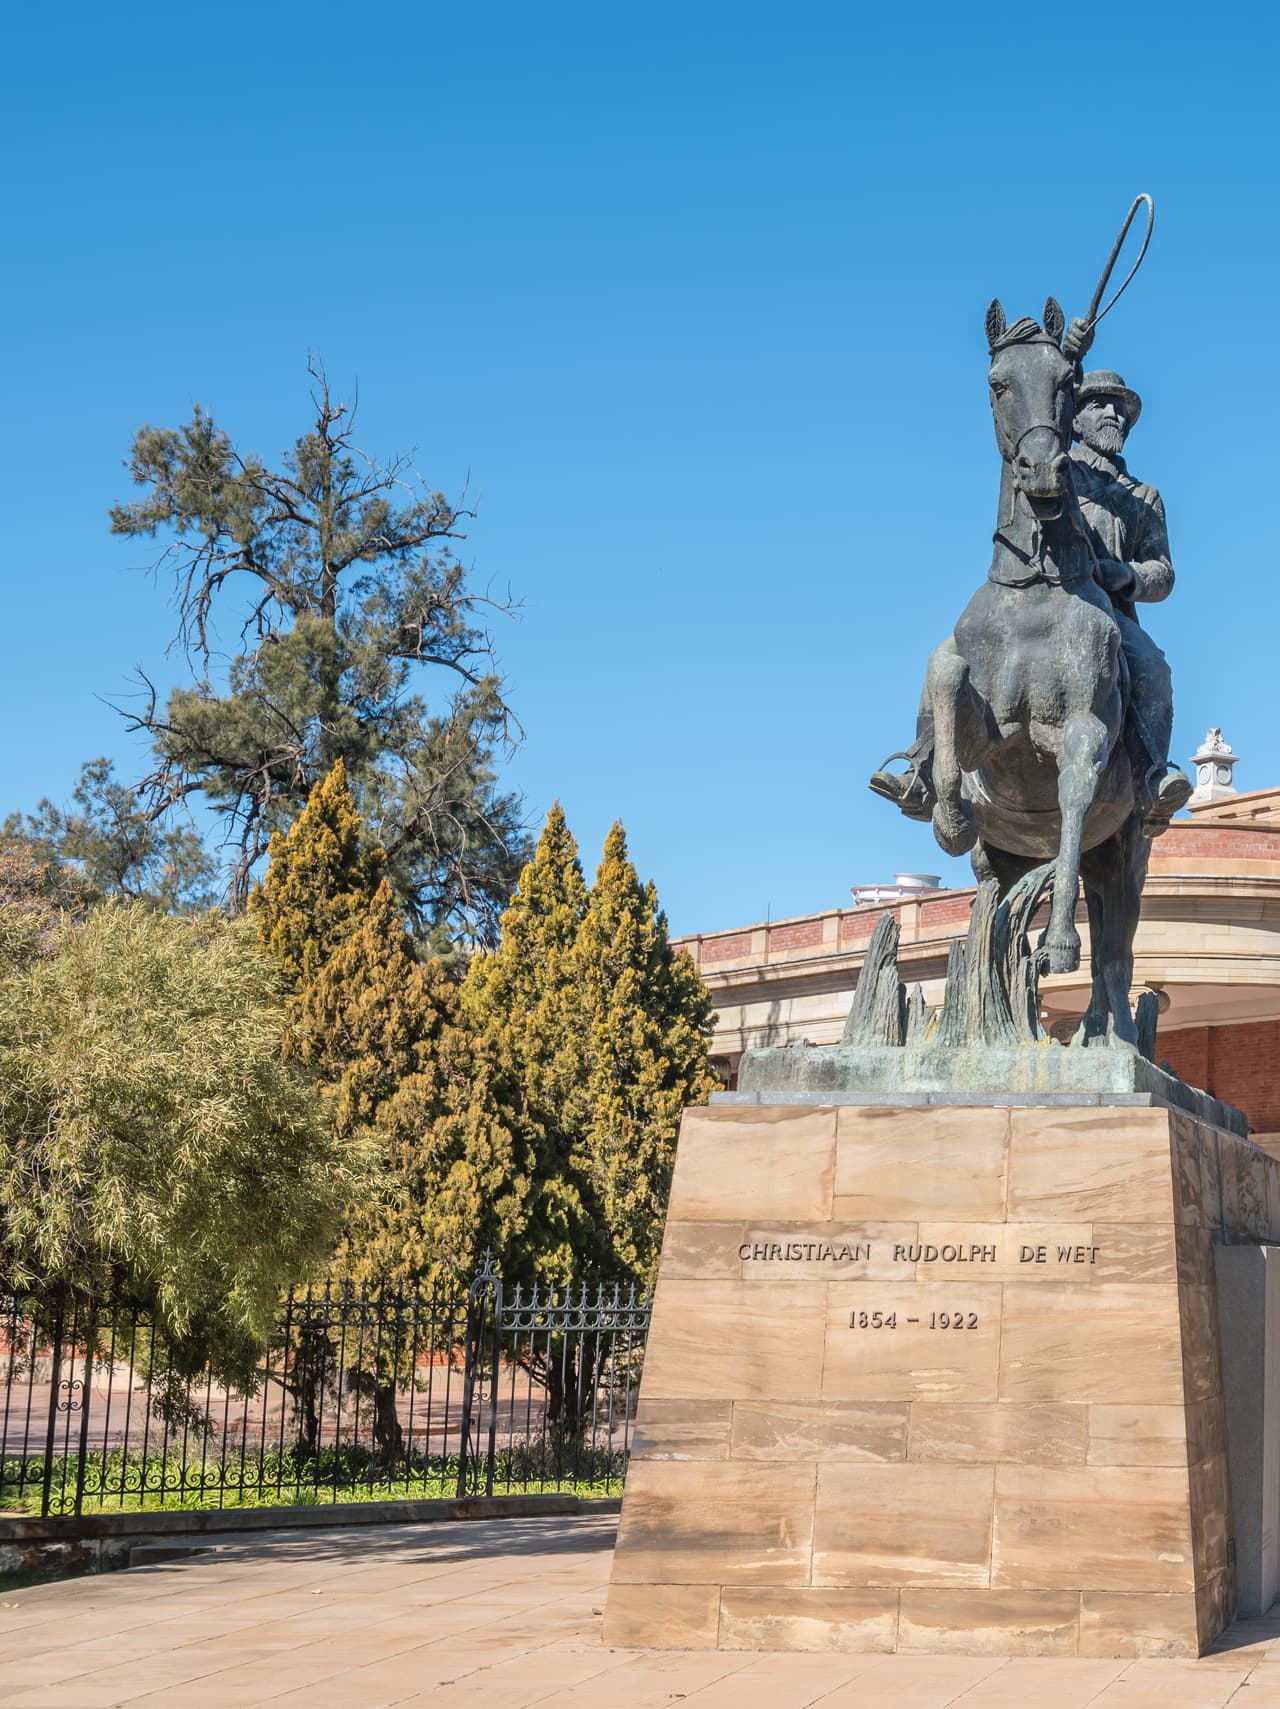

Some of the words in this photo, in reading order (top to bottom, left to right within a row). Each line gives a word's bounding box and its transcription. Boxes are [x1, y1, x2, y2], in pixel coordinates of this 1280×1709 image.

[738, 1244, 870, 1261] CHRISTIAAN
[893, 1245, 996, 1262] RUDOLPH
[1019, 1246, 1047, 1263] DE
[1057, 1246, 1100, 1264] WET
[849, 1311, 897, 1329] 1854
[929, 1312, 978, 1330] 1922
